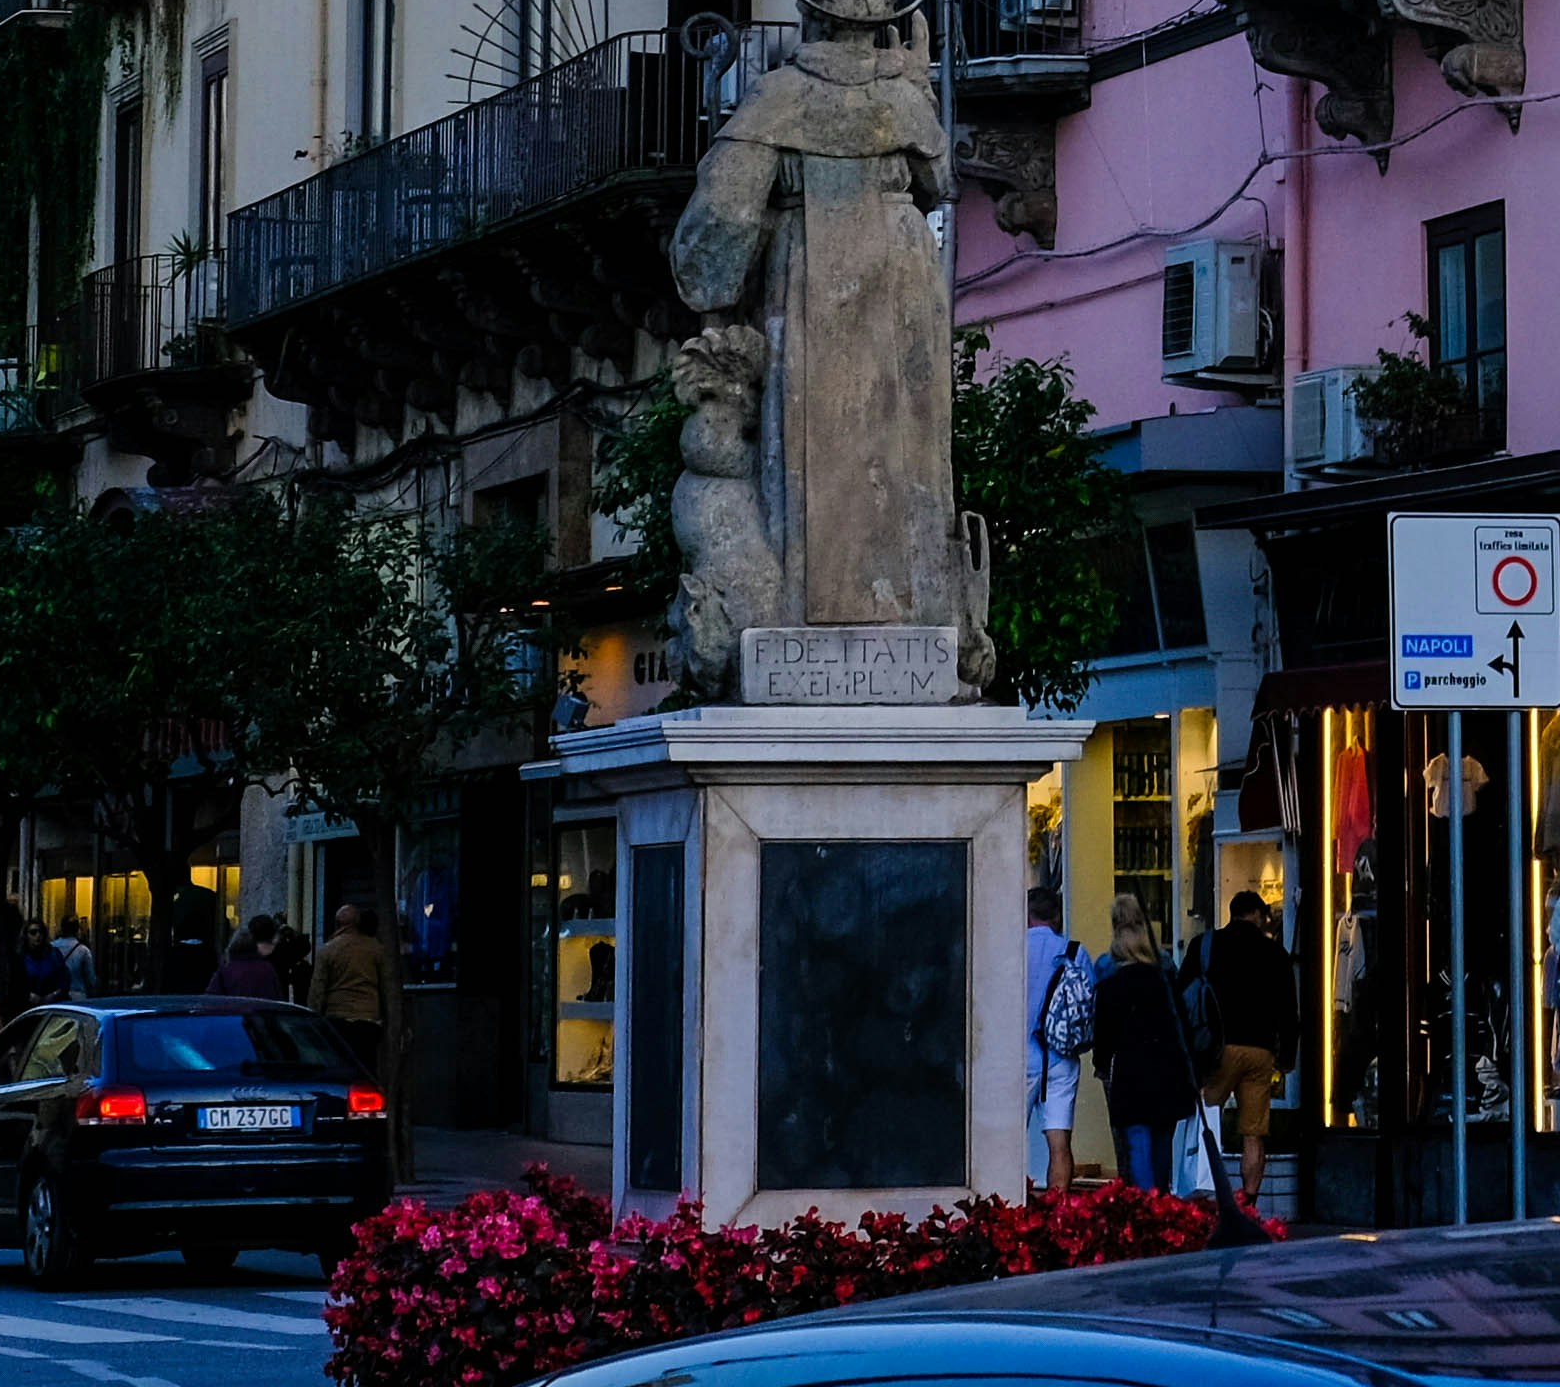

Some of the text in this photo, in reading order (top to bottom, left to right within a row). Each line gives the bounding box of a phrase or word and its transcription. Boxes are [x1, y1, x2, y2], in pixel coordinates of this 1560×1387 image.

[1479, 541, 1550, 552] traffico limitato
[755, 637, 950, 664] FIDELITATIS
[1405, 638, 1468, 654] NAPOLI
[1424, 673, 1487, 689] parcheggio
[236, 1107, 290, 1127] 237GC
